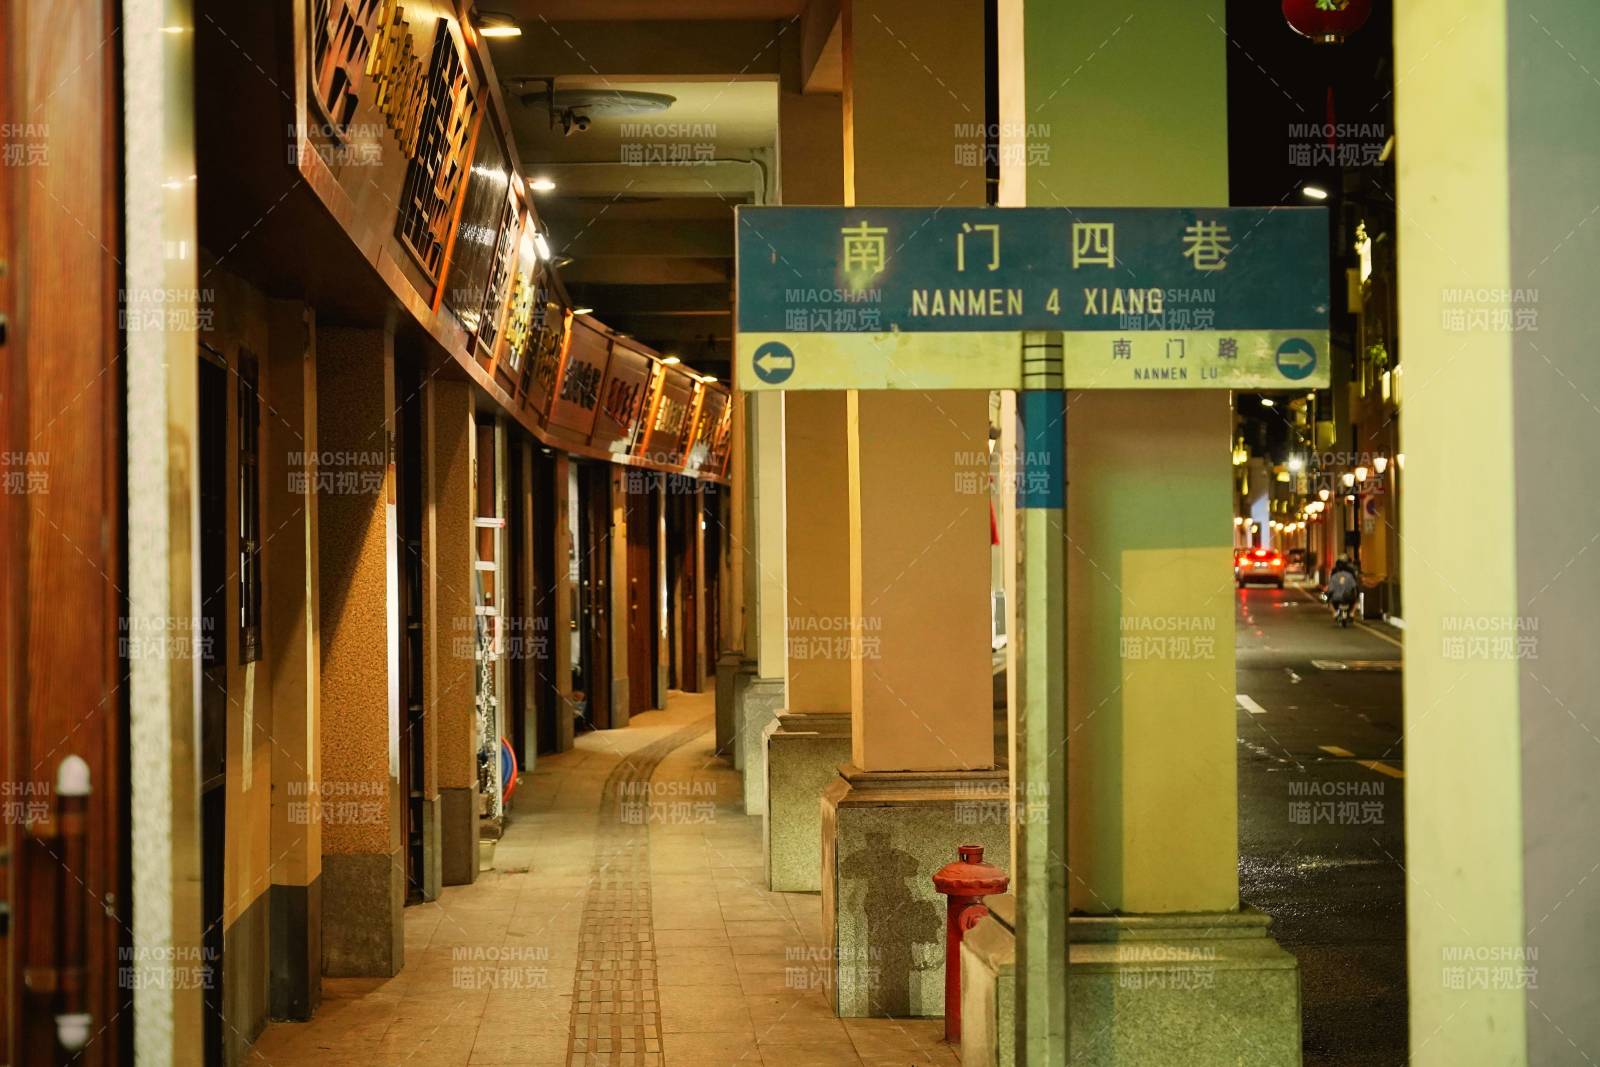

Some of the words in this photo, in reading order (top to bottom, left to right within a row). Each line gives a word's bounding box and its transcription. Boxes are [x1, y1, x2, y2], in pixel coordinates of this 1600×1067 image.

[841, 220, 1231, 272] 南门四巷
[912, 288, 1024, 317] NANMEN
[1045, 289, 1061, 316] 4
[1084, 287, 1164, 315] XIANG
[1112, 337, 1239, 360] 南门路
[1133, 367, 1188, 380] NANMEN
[1200, 367, 1219, 380] LU
